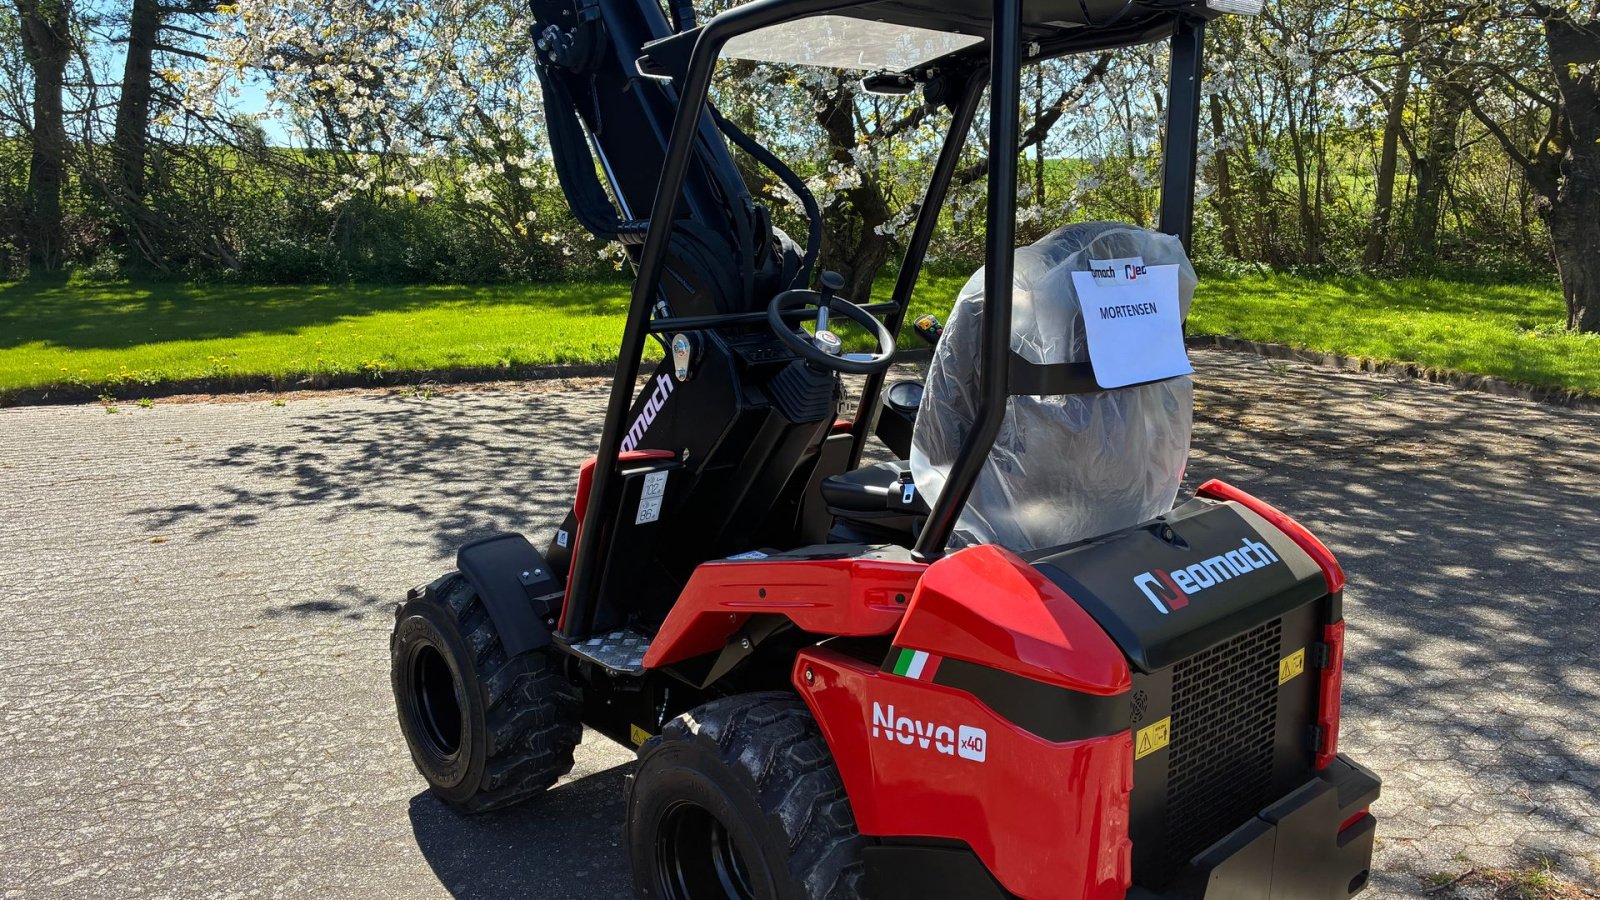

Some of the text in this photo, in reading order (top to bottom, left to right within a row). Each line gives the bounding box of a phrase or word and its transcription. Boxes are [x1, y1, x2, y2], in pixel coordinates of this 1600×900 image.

[1099, 302, 1158, 320] MORTENSEN
[1133, 537, 1279, 615] Neomach
[872, 701, 983, 756] Nova x40
